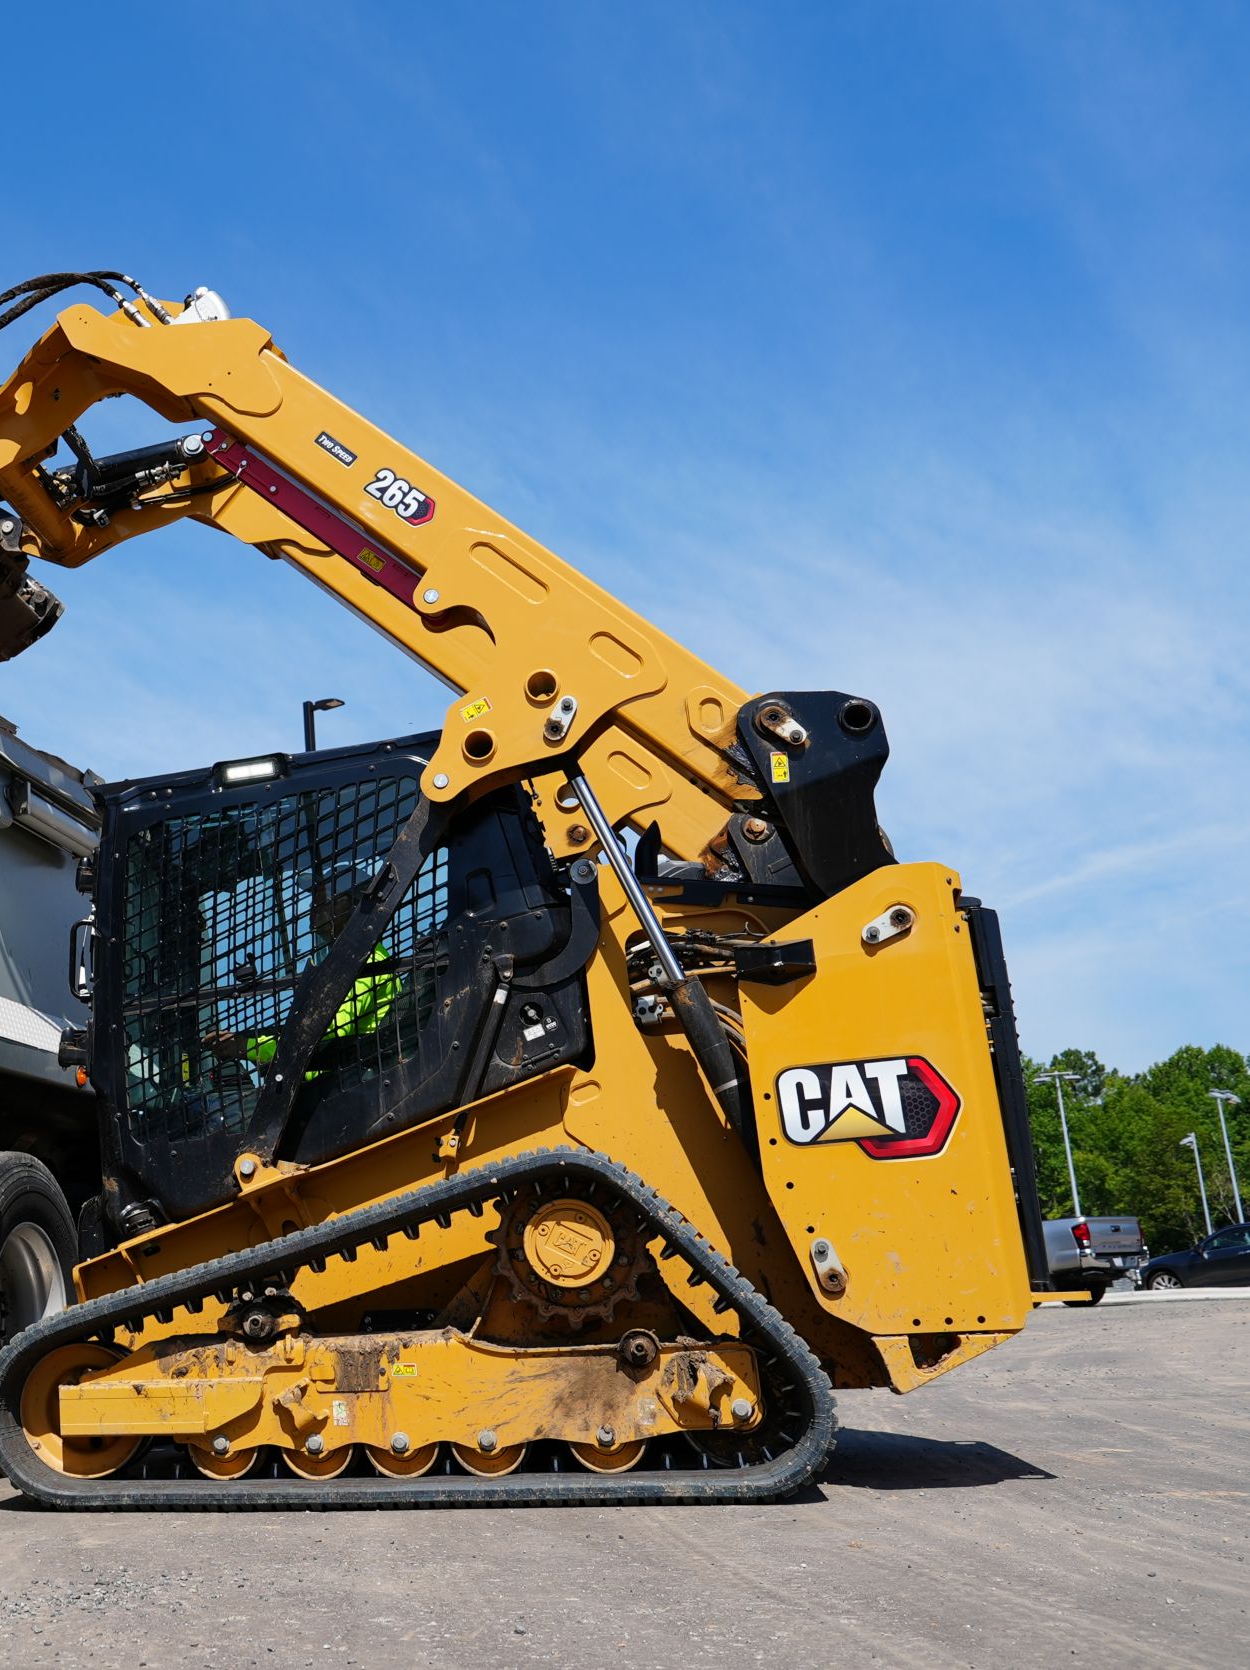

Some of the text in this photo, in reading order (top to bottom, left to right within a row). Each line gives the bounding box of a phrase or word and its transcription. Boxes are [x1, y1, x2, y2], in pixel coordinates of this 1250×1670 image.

[364, 468, 427, 518] 265
[778, 1059, 908, 1143] CAT
[552, 1229, 588, 1257] CAT
